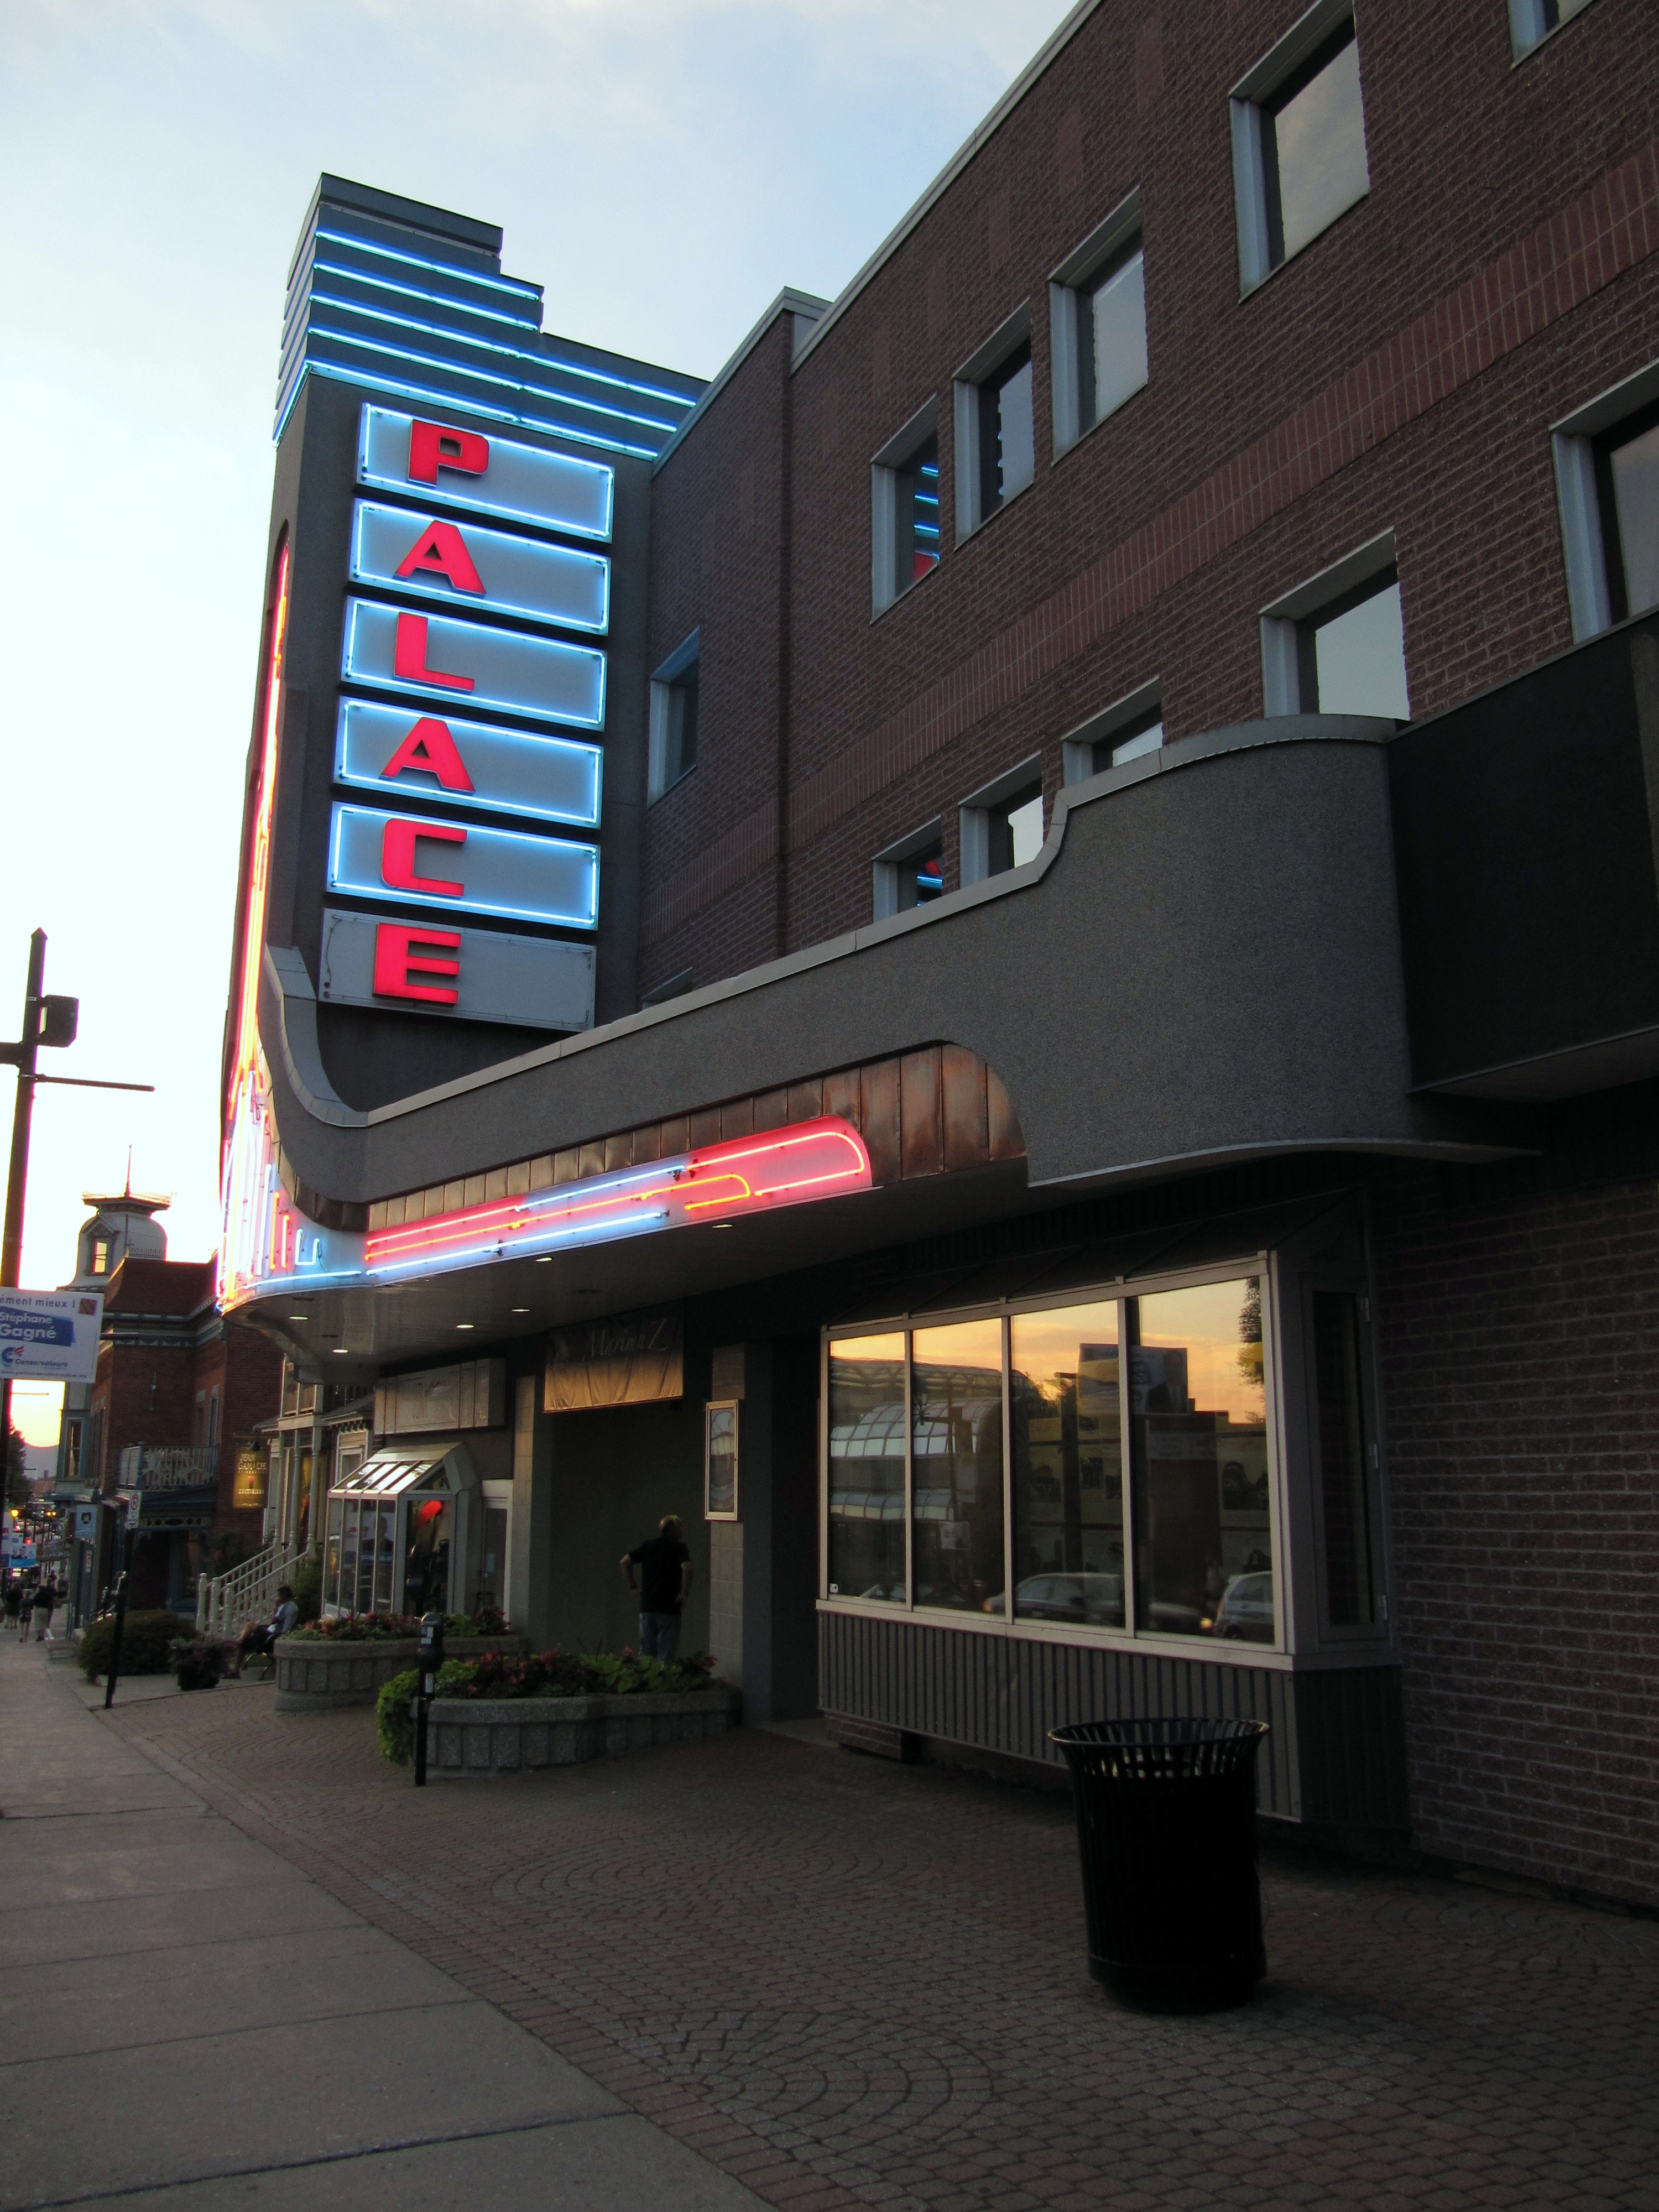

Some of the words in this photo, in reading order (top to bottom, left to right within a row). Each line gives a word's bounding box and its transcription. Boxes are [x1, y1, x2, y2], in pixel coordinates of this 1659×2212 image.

[372, 419, 490, 1004] PALACE
[35, 1297, 67, 1308] mieux
[0, 1311, 53, 1324] Stéphane
[0, 1323, 57, 1341] Gagné
[15, 1358, 68, 1367] Conservateurs
[239, 1453, 255, 1462] JEAN
